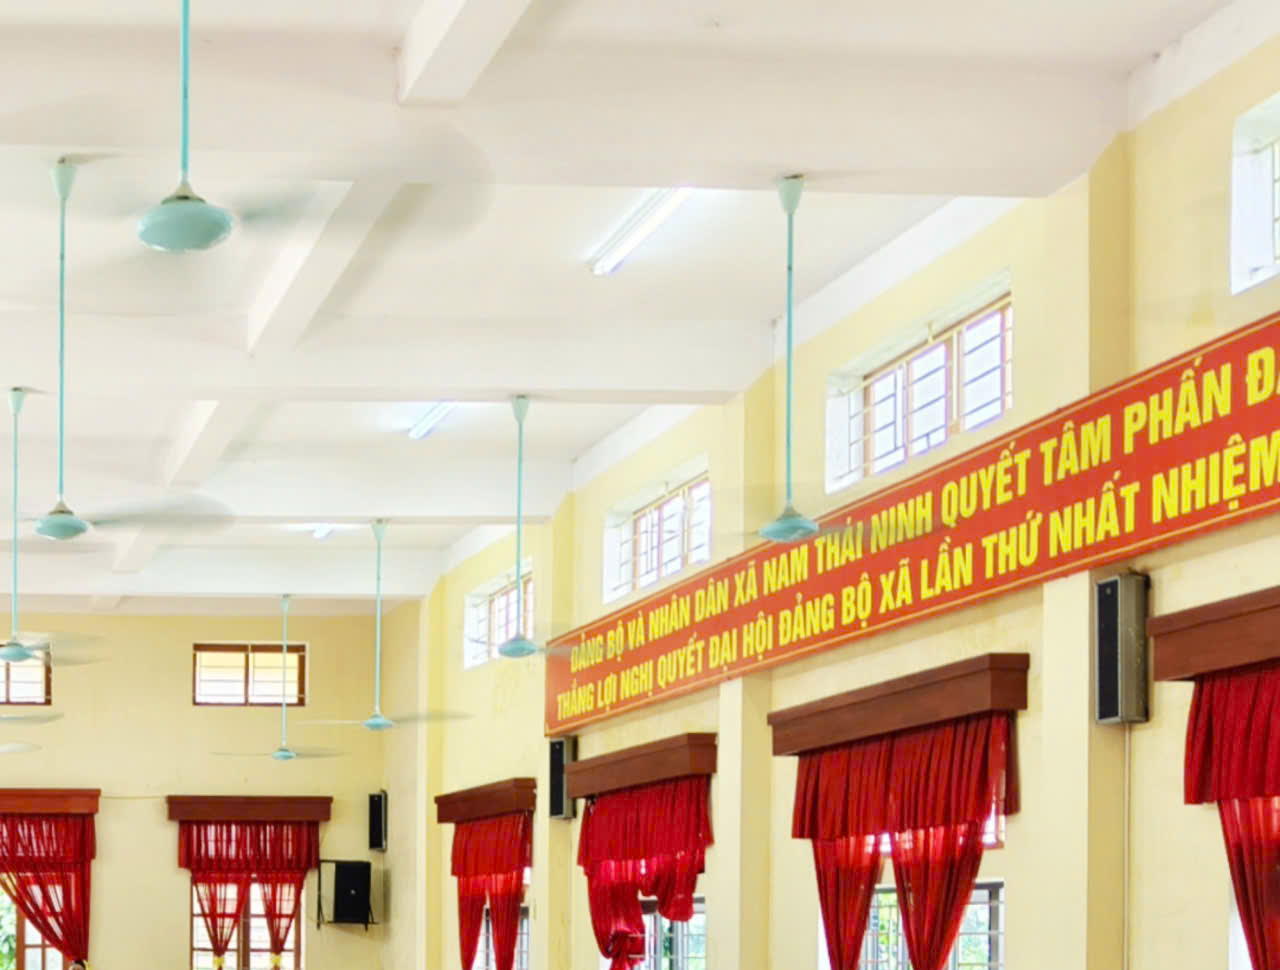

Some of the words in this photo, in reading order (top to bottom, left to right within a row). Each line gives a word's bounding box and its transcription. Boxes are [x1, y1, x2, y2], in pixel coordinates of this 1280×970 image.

[606, 619, 624, 662] BỘ
[627, 610, 645, 651] VÀ
[648, 594, 690, 642] NHÂN
[694, 578, 730, 624] DÂN
[733, 560, 758, 608] XÃ
[763, 544, 809, 596] NAM
[814, 517, 864, 574] THÁI
[870, 492, 933, 553] NINH
[941, 440, 1031, 528] QUYẾT
[1040, 415, 1112, 487] TÂM
[1123, 356, 1232, 455] PHẤN
[1246, 346, 1280, 406] Đ
[620, 659, 653, 700] NGHỊ
[657, 632, 705, 689] QUYẾT
[708, 630, 737, 671] ĐẠI
[742, 611, 773, 662] HỘI
[778, 593, 835, 647] ĐẢNG
[841, 572, 872, 628] BỘ
[879, 558, 913, 614] XÃ
[920, 536, 973, 600] LẦN
[981, 512, 1043, 579] THỨ
[1049, 471, 1140, 558] NHẤT
[1152, 429, 1280, 524] NHIỆM
